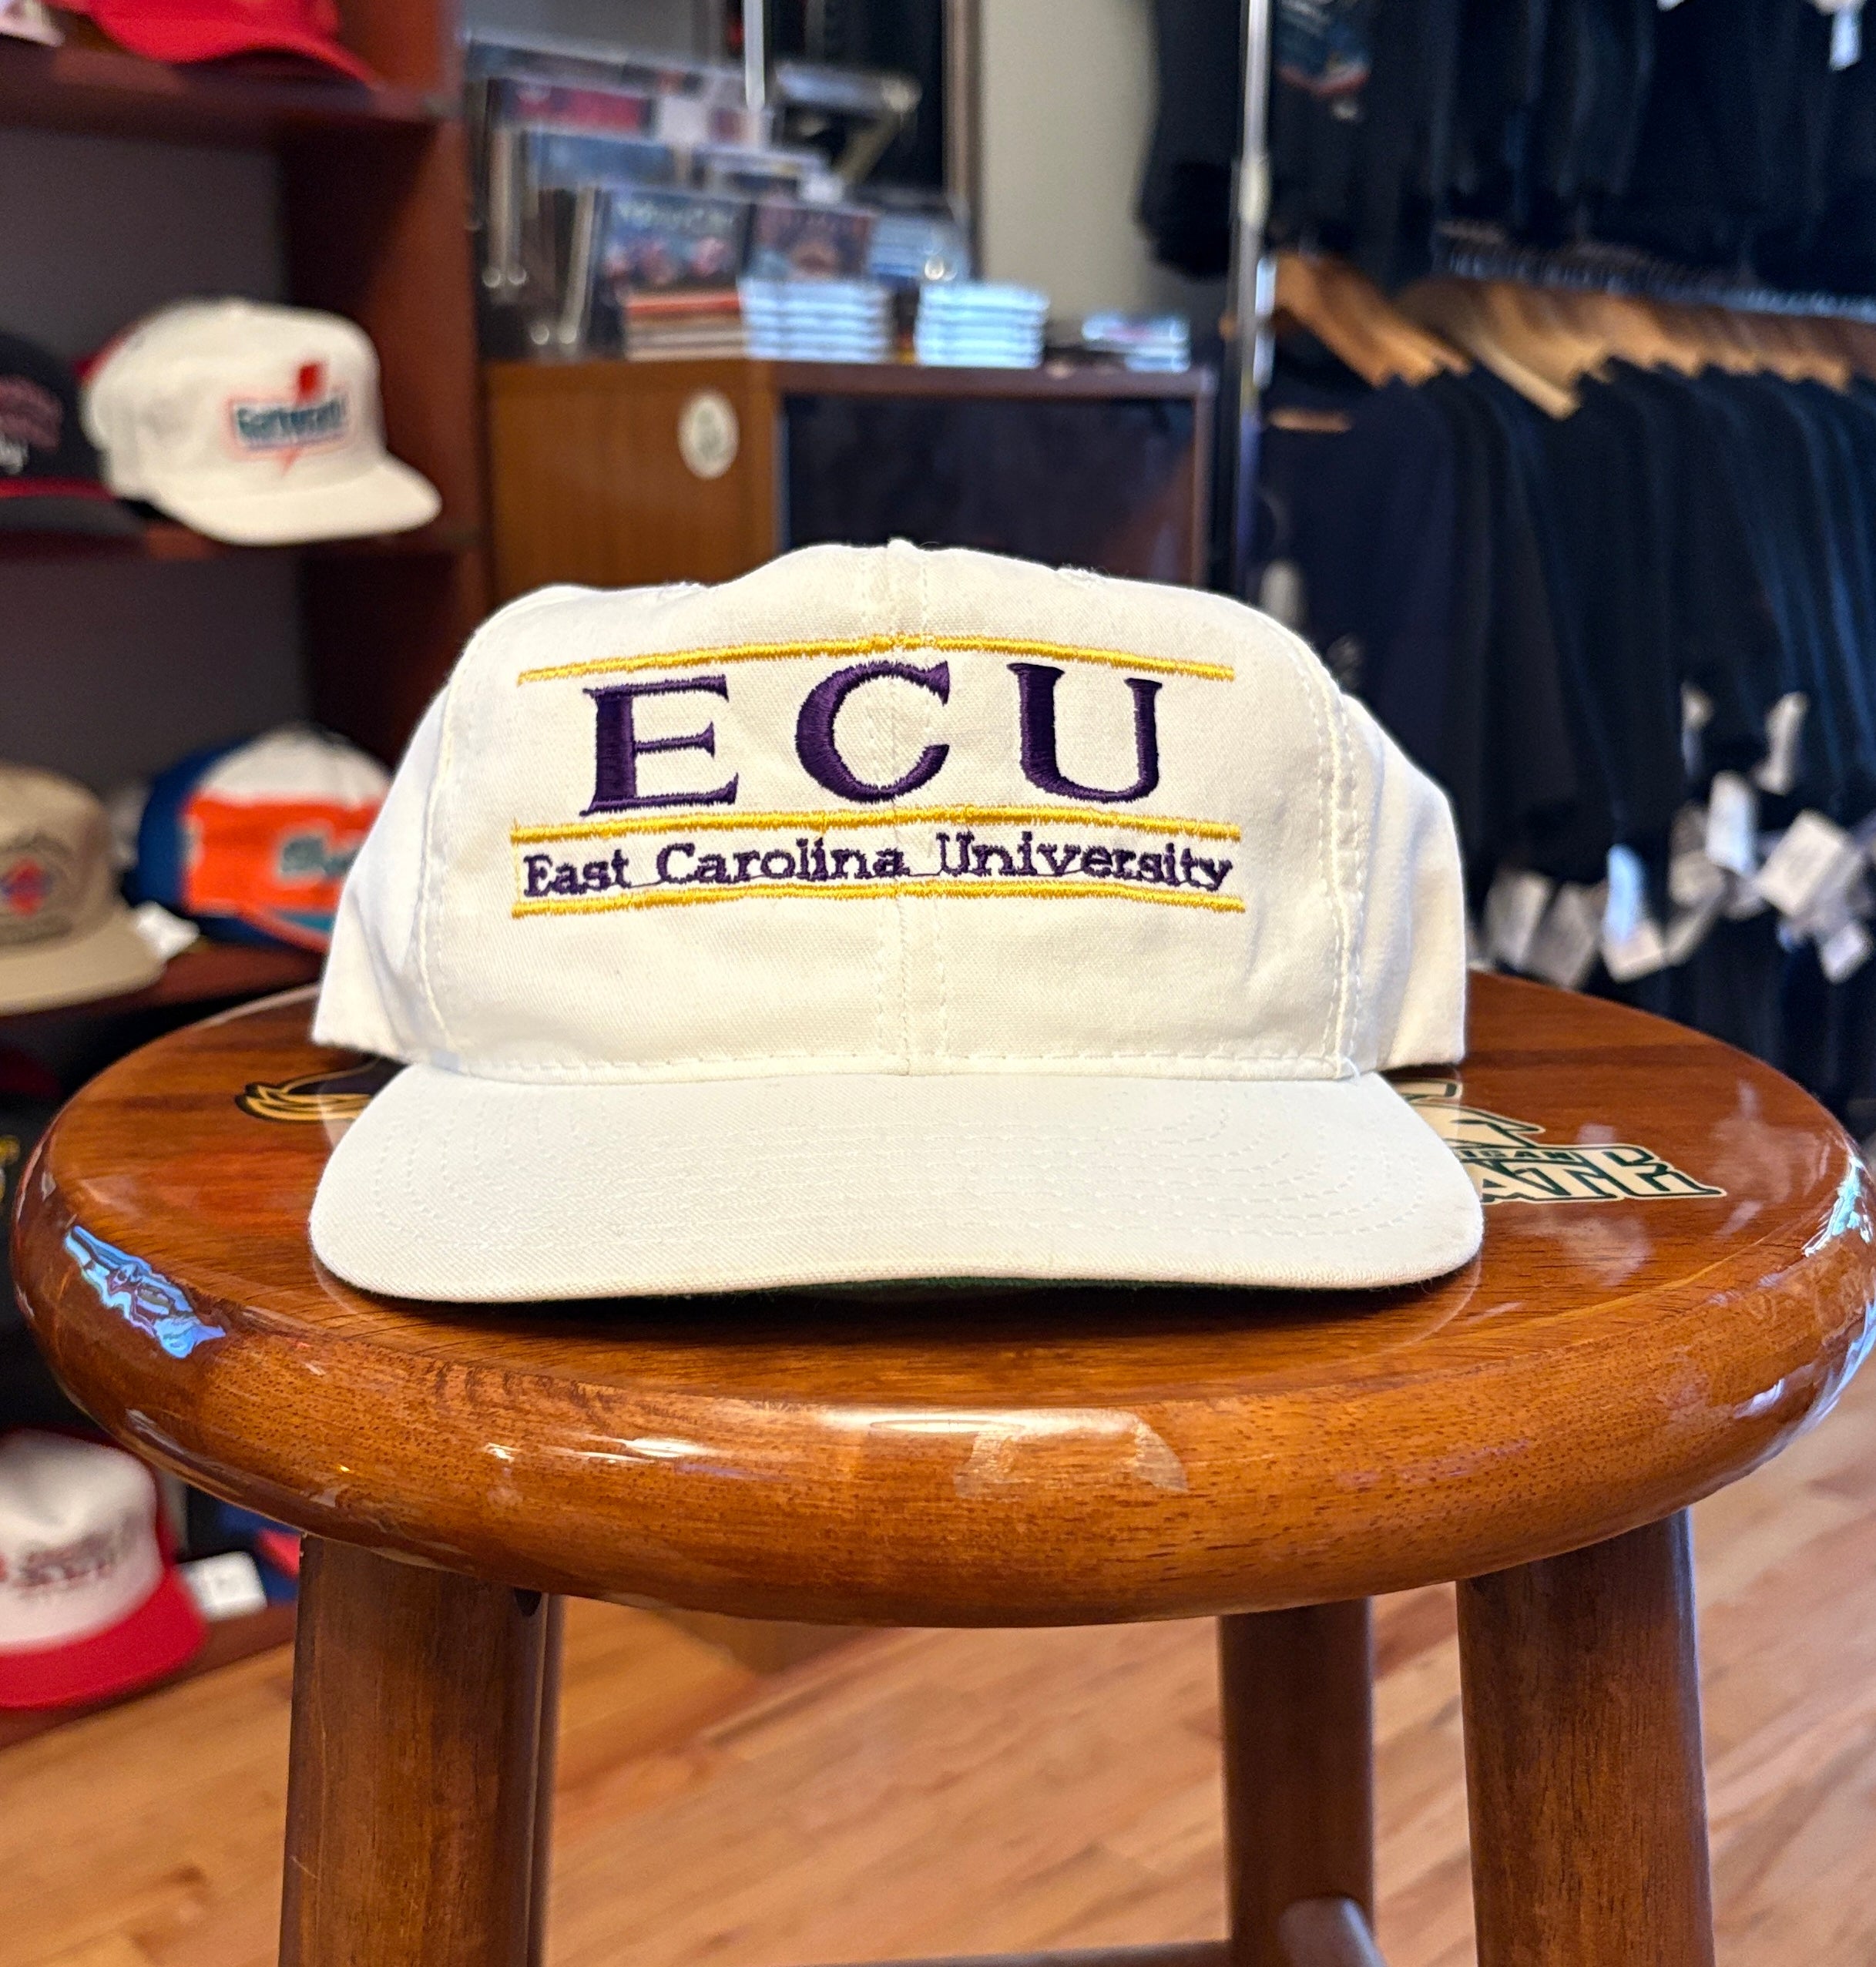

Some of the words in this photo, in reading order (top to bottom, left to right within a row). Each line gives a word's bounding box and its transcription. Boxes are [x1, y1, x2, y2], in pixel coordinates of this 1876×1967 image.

[580, 660, 1162, 817] ECU
[524, 848, 632, 898] East
[655, 838, 909, 884] Carolina
[935, 831, 1233, 891] University
